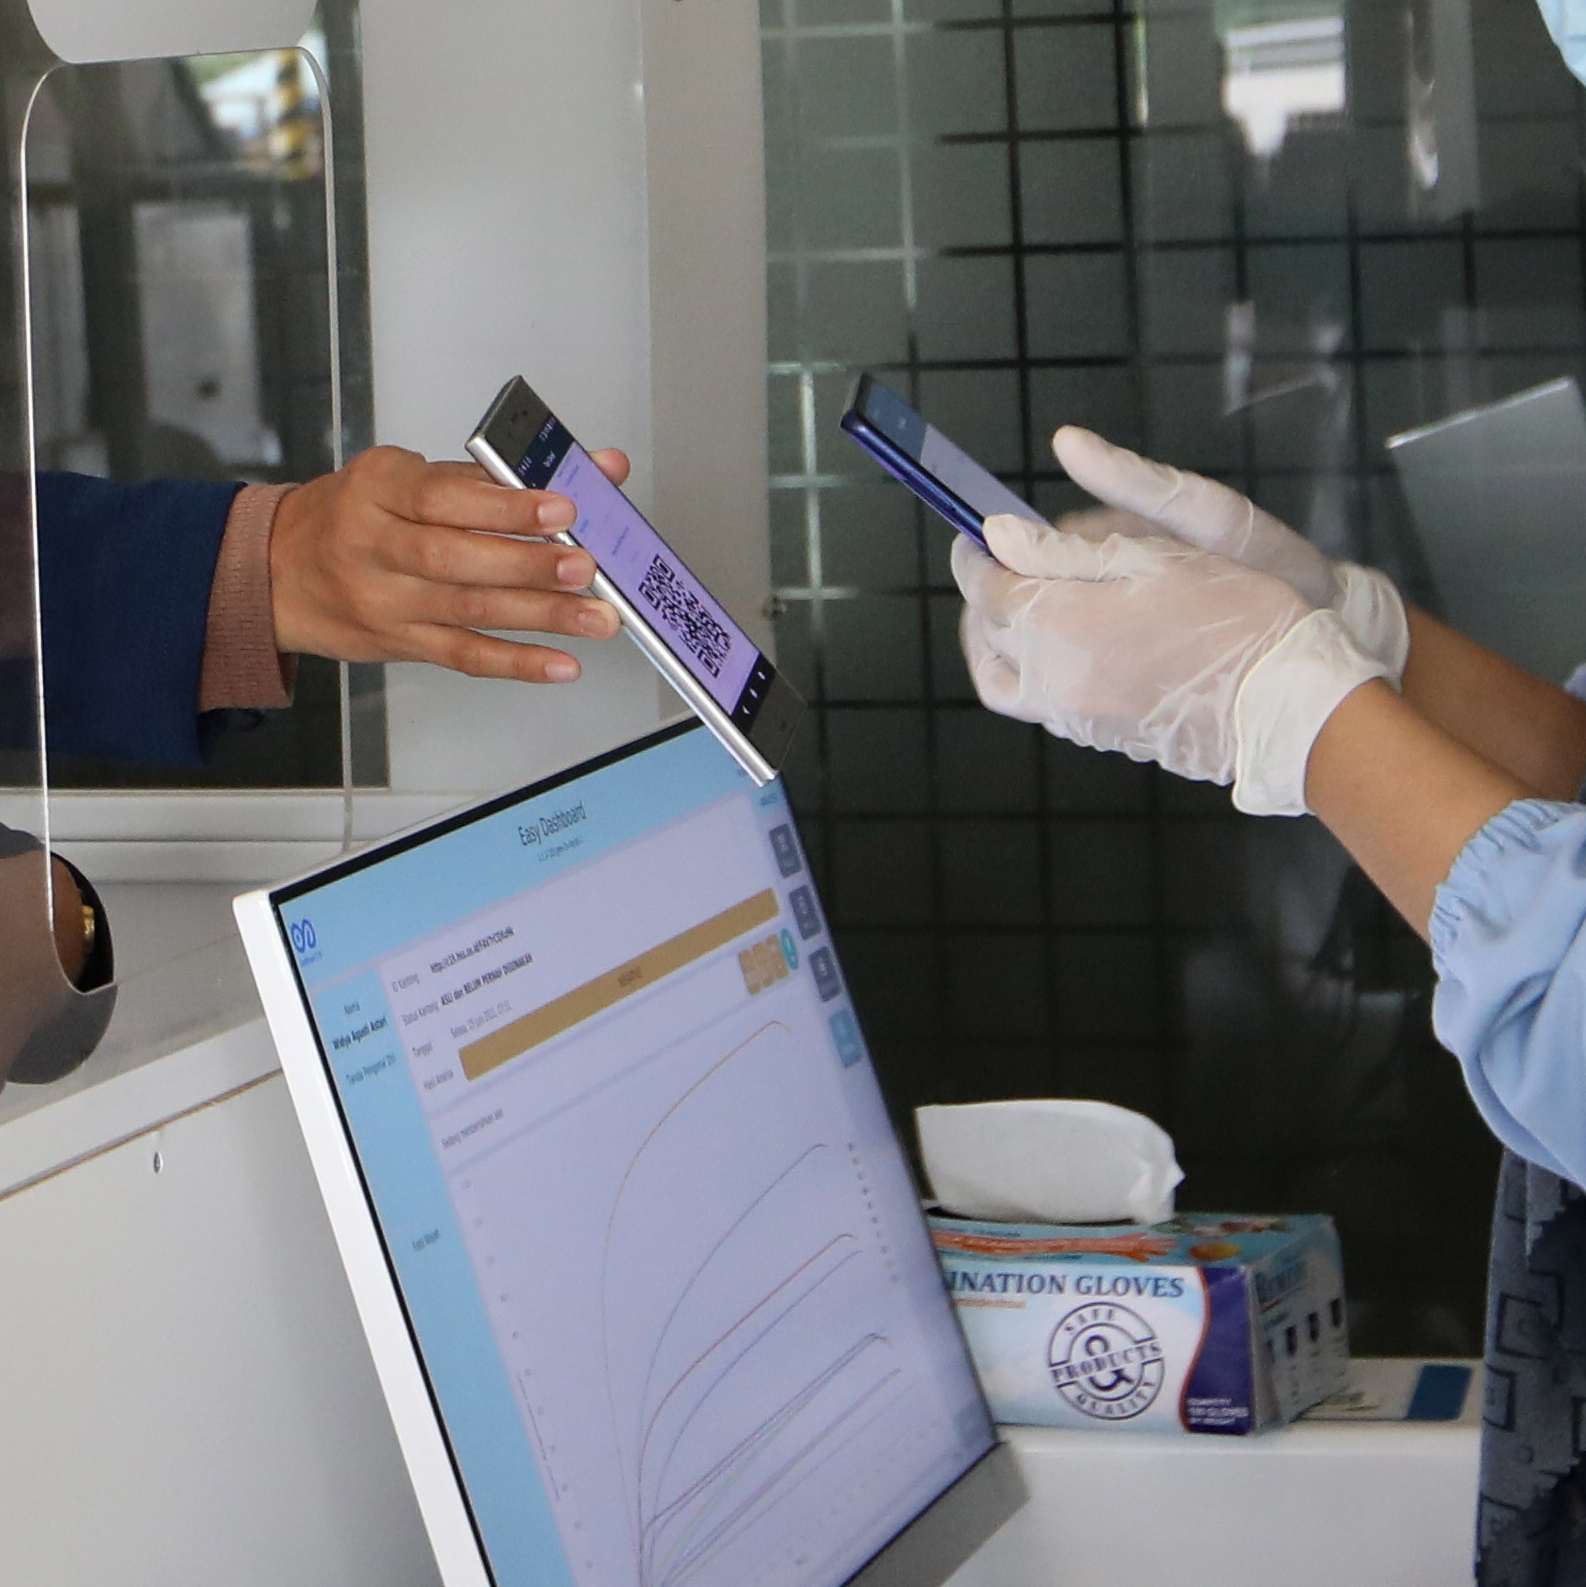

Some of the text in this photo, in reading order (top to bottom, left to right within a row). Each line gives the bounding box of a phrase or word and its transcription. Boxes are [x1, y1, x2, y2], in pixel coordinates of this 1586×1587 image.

[518, 800, 587, 846] Easy Dashboard
[945, 1270, 1184, 1299] INATION GLOVES
[1063, 1307, 1117, 1334] SAFE
[1051, 1341, 1163, 1383] PRODUCTS
[1075, 1379, 1156, 1415] QUALITY
